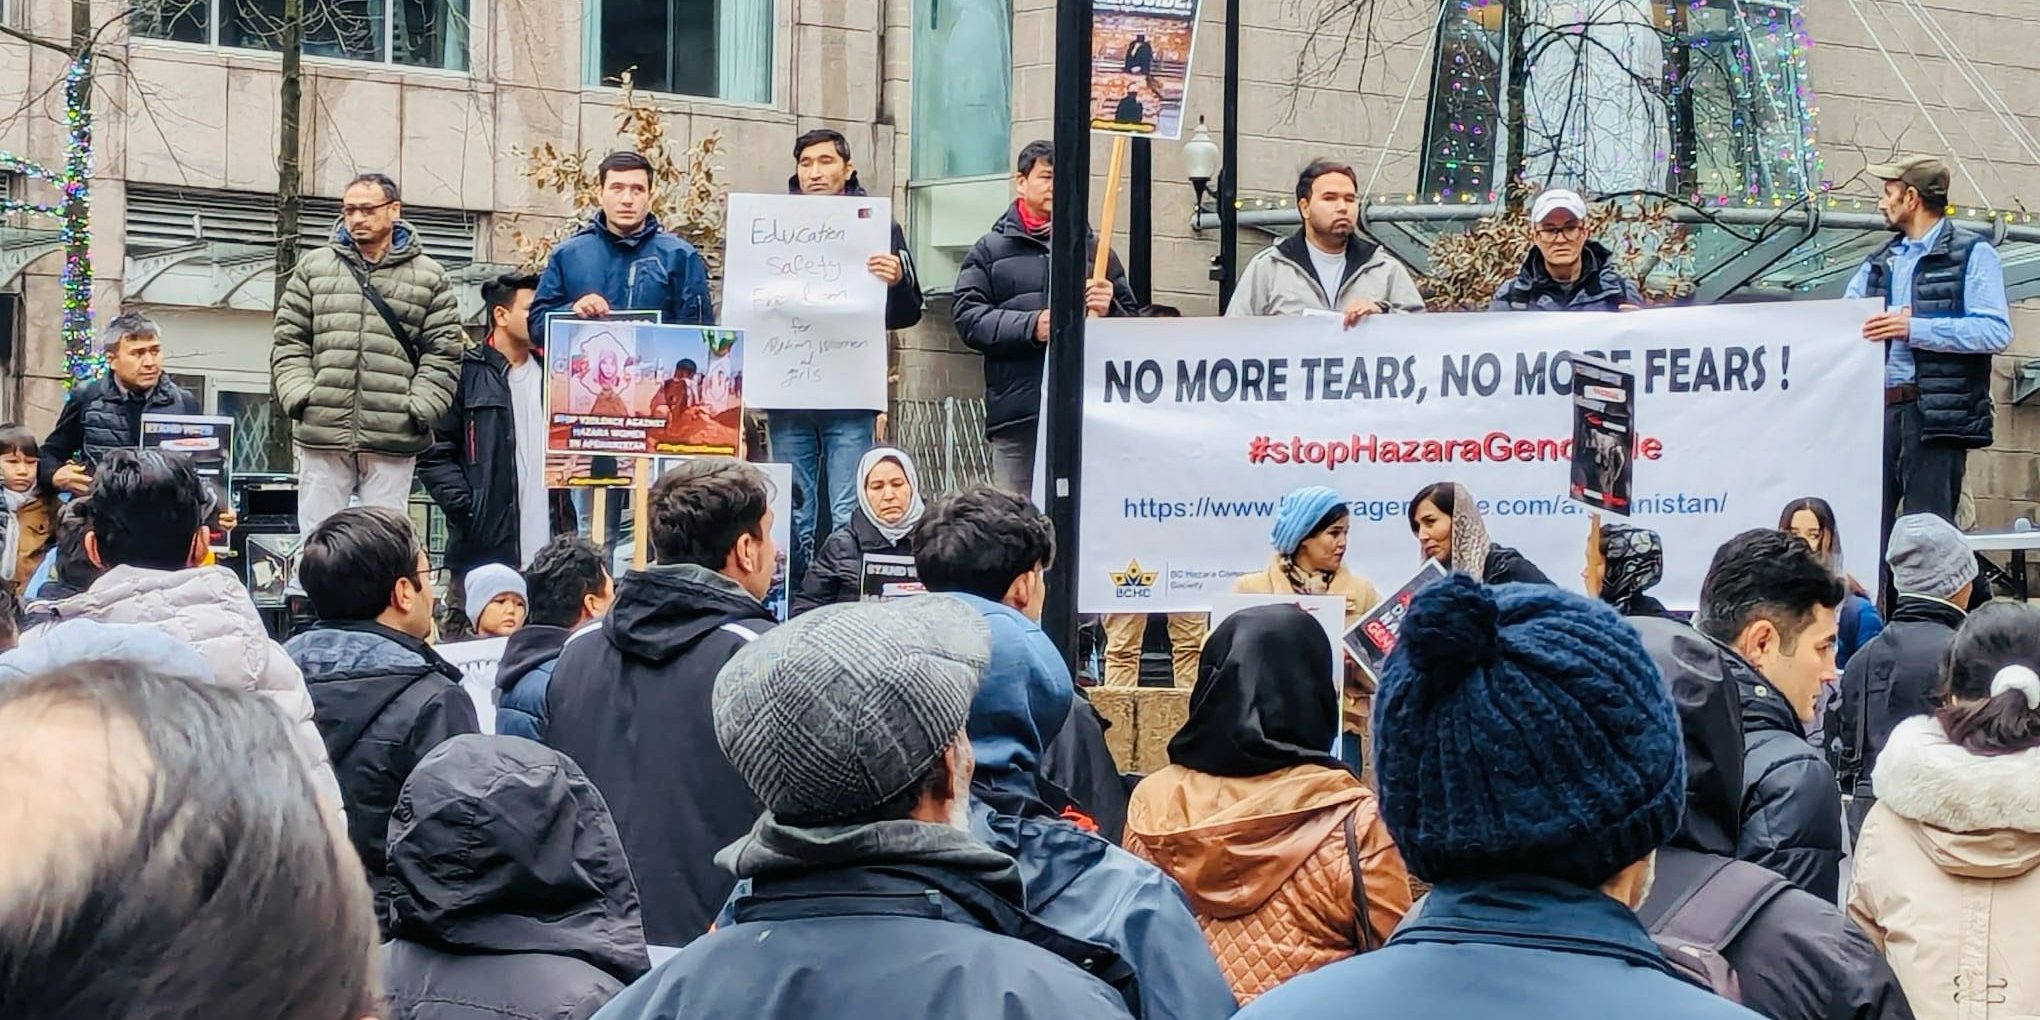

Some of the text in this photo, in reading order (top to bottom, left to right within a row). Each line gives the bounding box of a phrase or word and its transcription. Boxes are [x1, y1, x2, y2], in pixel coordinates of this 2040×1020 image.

[751, 217, 846, 245] Education
[766, 255, 841, 281] Safety
[1104, 359, 1163, 403] NO
[1175, 358, 1287, 402] MORE
[1300, 355, 1427, 404] TEARS,
[1440, 352, 1501, 397] NO
[1514, 350, 1631, 396] MO
[1645, 345, 1767, 394] FEARS
[1248, 432, 1662, 470] #stopHazaraGenoe
